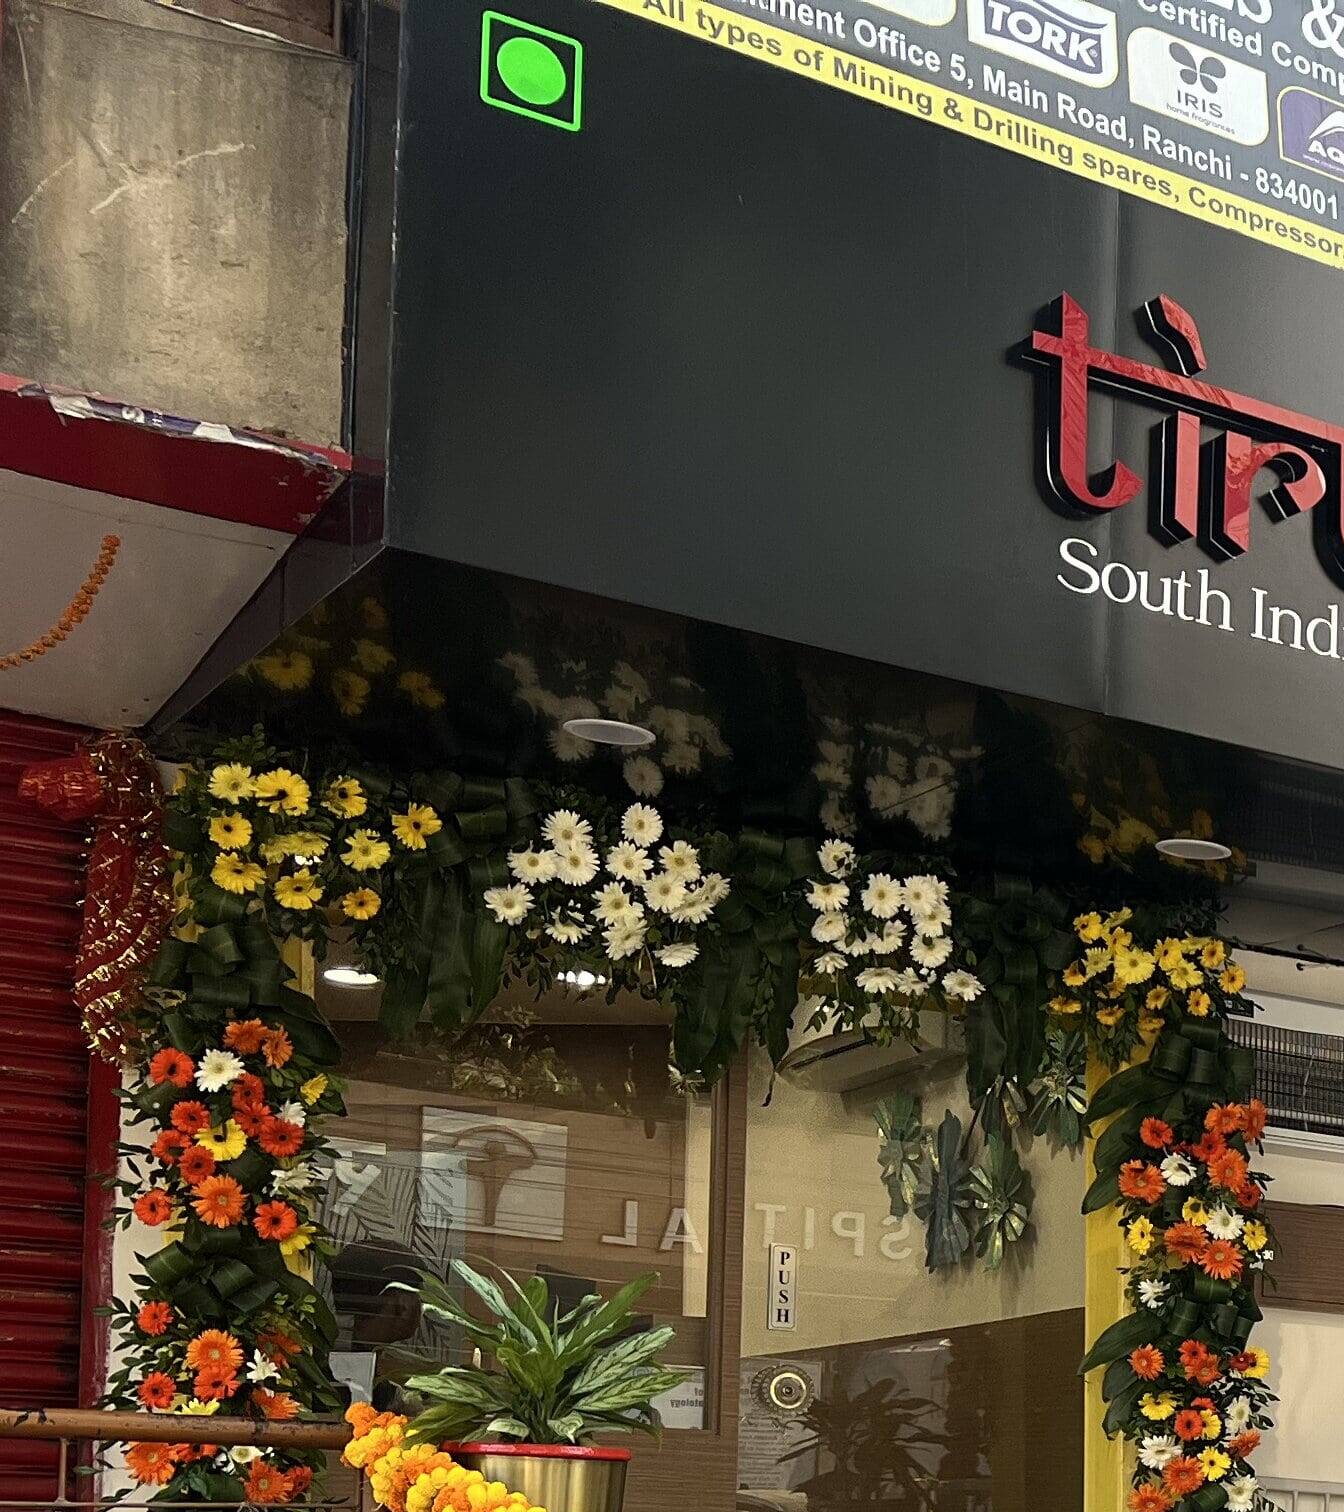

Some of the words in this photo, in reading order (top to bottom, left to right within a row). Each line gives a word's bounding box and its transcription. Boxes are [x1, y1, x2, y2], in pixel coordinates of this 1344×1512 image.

[986, 1, 1098, 68] TORK
[643, 0, 685, 23] All
[696, 7, 782, 57] types
[794, 44, 824, 72] of
[834, 57, 933, 117] Mining
[943, 97, 964, 123] &
[974, 107, 1074, 167] Drilling
[1083, 151, 1180, 203] spares,
[853, 18, 941, 73] Office
[950, 53, 974, 90] 5,
[983, 65, 1048, 113] Main
[1056, 92, 1135, 149] Road,
[1142, 124, 1233, 181] Ranchi
[1255, 167, 1339, 220] 834001
[1176, 90, 1223, 119] IRIS
[1057, 536, 1235, 633] South
[775, 1250, 792, 1326] PUSH
